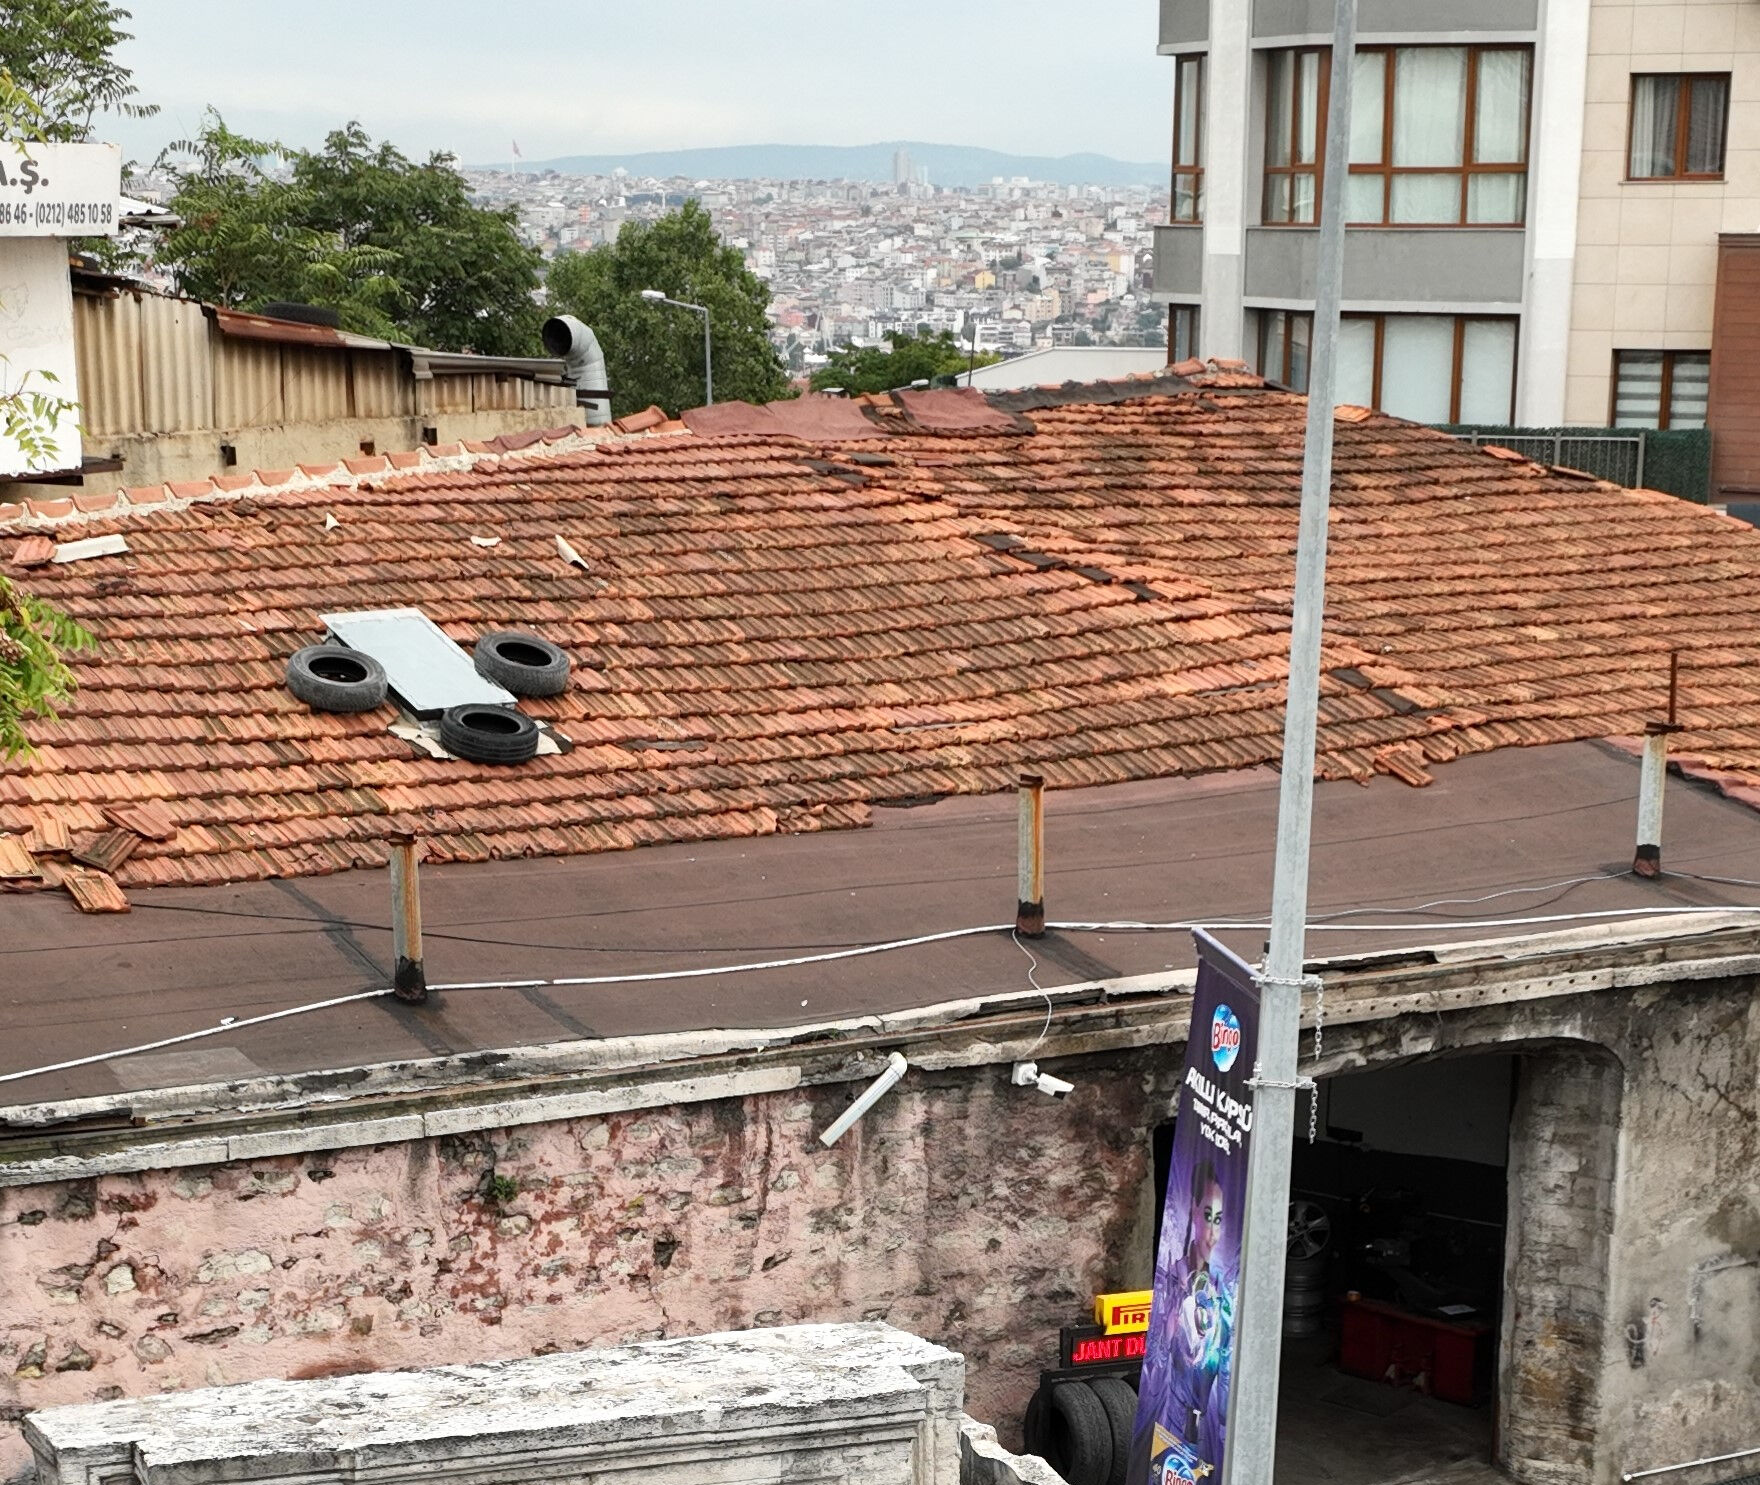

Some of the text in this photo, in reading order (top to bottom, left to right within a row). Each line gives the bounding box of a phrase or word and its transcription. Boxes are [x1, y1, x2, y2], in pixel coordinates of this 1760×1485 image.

[0, 203, 11, 224] 86
[14, 203, 27, 224] 46
[35, 202, 65, 227] (0212)
[67, 203, 86, 224] 485
[88, 203, 99, 224] 10
[100, 203, 112, 224] 58
[1212, 1023, 1239, 1050] Bingo
[1112, 1303, 1151, 1326] PIR
[1073, 1340, 1122, 1361] JANT
